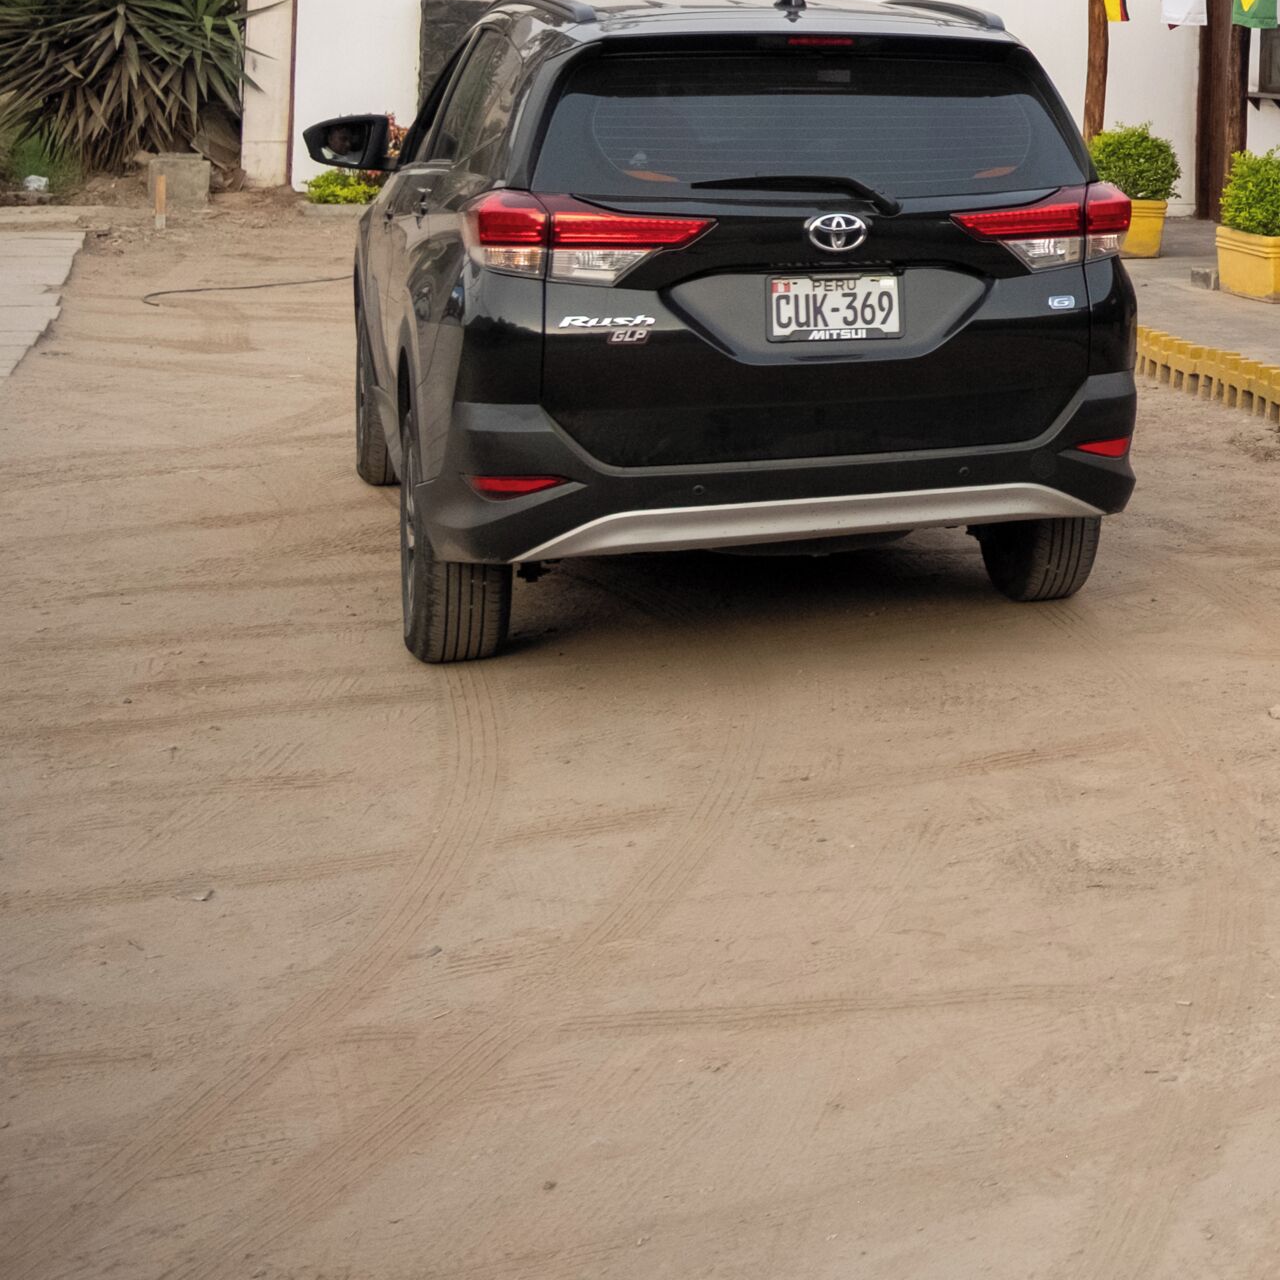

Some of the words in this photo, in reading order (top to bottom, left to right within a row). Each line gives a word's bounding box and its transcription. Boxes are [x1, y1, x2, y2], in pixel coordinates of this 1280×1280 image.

[812, 278, 858, 292] PERU
[775, 291, 894, 329] CUK-369
[558, 315, 656, 328] Rush
[611, 329, 648, 342] GLP
[808, 328, 867, 340] MITSUI
